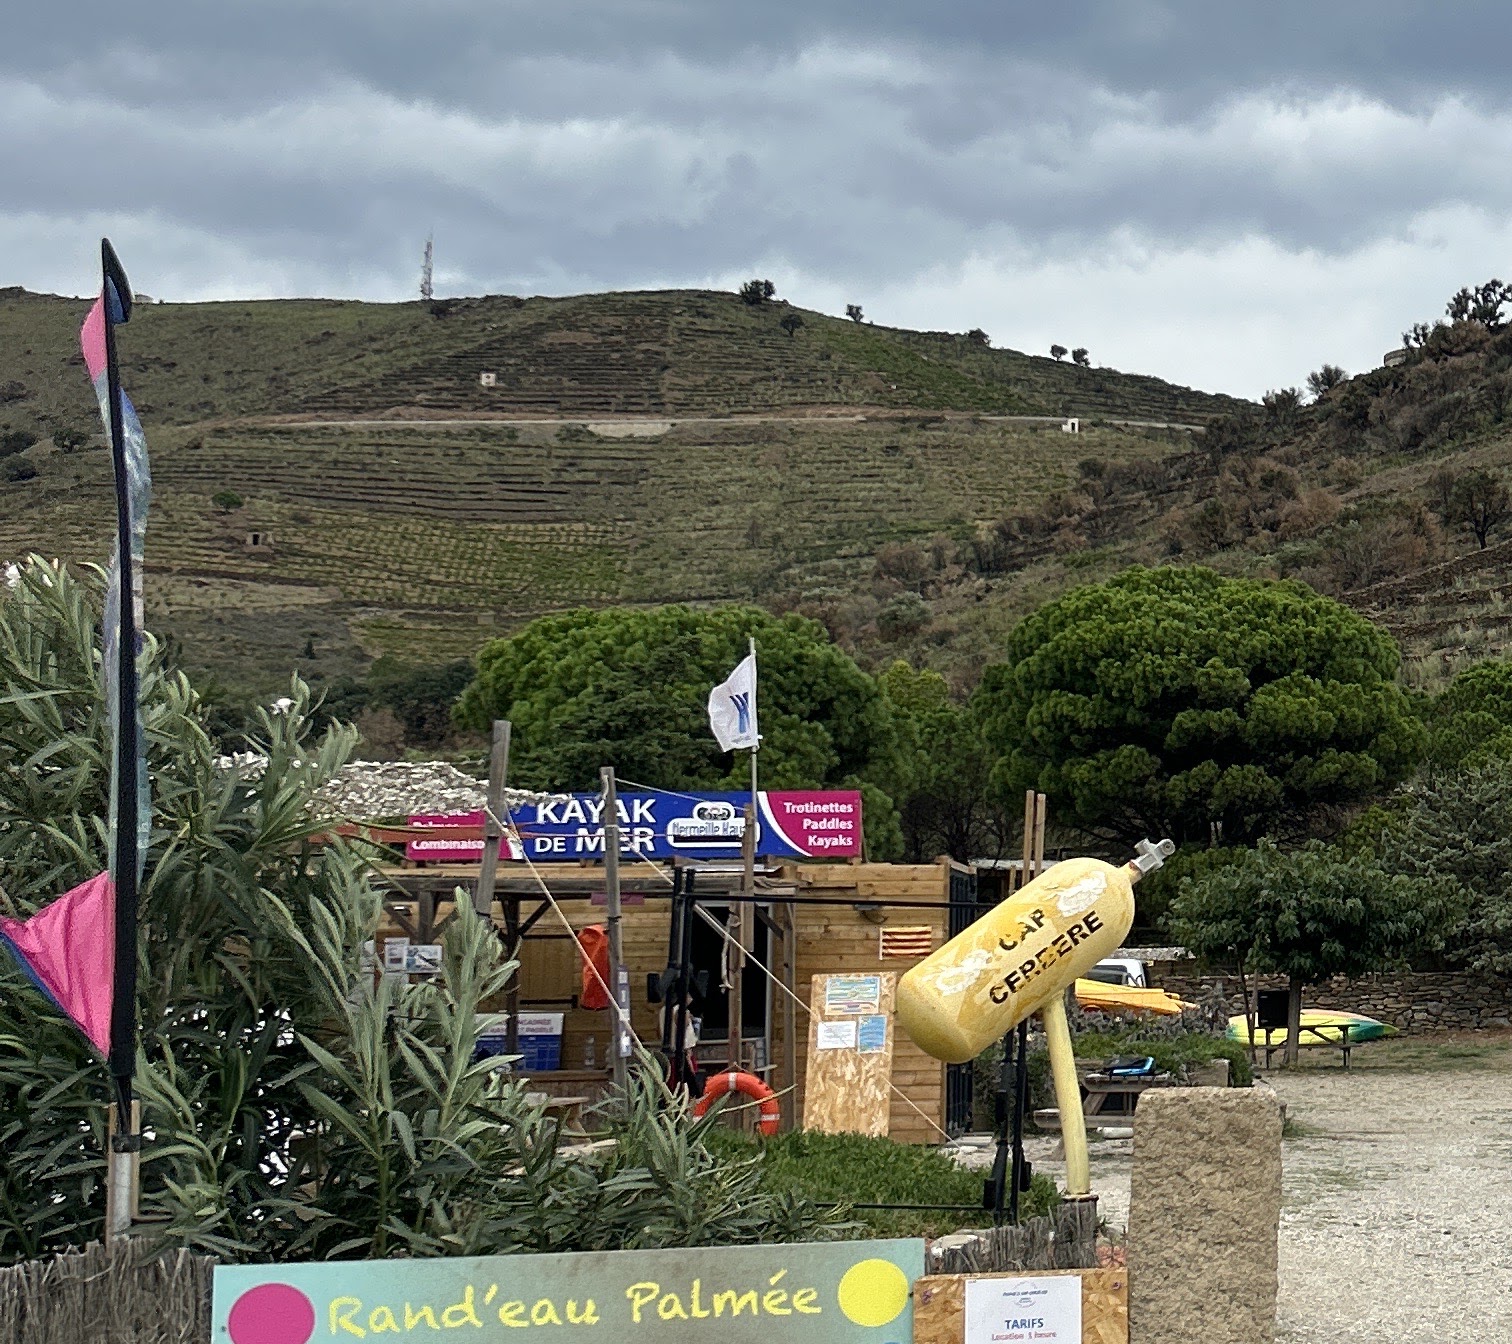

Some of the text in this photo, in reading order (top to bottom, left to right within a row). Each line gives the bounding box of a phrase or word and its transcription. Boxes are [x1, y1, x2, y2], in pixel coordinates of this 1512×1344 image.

[536, 798, 657, 824] KAYAK
[783, 802, 854, 814] Trotinettes
[803, 818, 854, 830] Paddles
[411, 839, 486, 850] Combinaiso
[534, 827, 656, 853] DE MER
[808, 834, 853, 849] Kayaks
[998, 908, 1046, 951] CAP
[327, 1268, 823, 1340] Rand'eau Palmée
[1004, 1317, 1044, 1330] TARIFS
